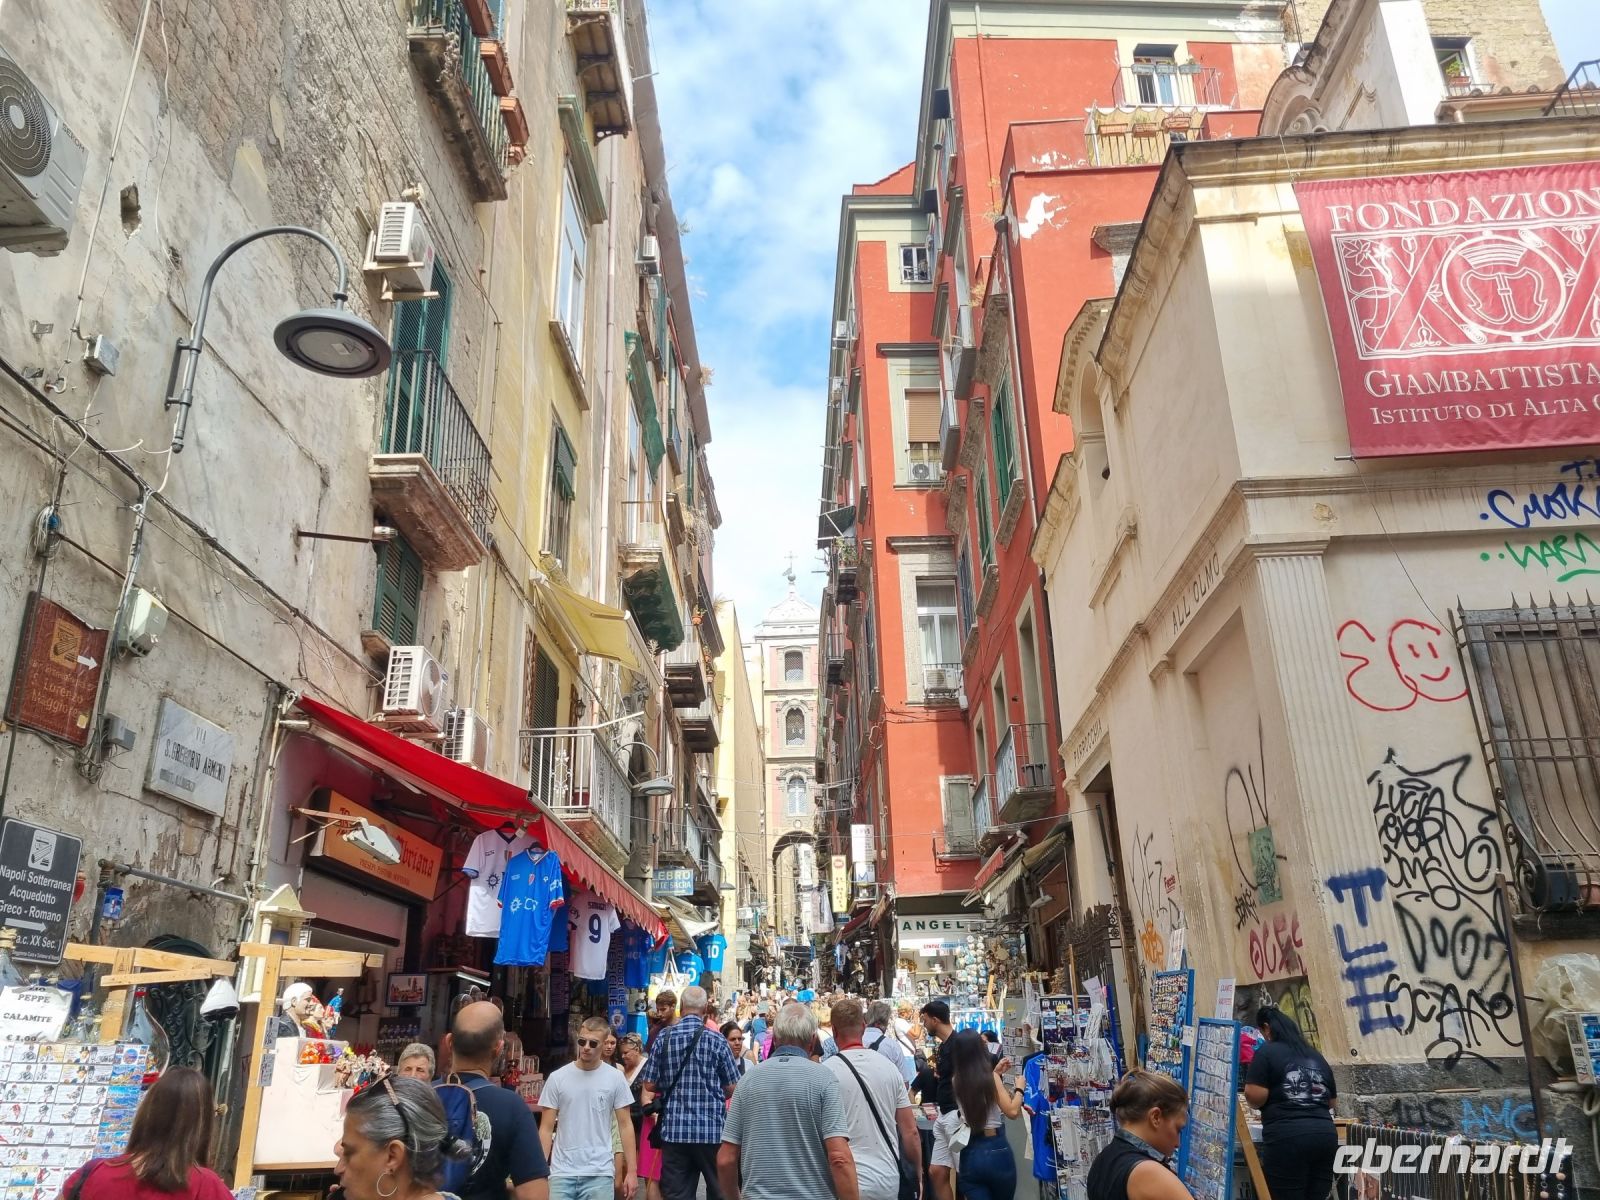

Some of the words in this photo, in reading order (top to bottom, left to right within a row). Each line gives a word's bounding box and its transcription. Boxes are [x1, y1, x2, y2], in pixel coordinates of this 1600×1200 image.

[1364, 362, 1600, 398] GIAMBATTISTA
[1370, 404, 1483, 425] ISTITUTO
[1488, 401, 1516, 419] DI
[1523, 397, 1588, 417] ALTA
[1172, 552, 1220, 635] ALL'OLMO
[0, 865, 27, 882] Napoli
[27, 871, 72, 892] Sotterranea
[652, 871, 691, 881] EBRO
[9, 885, 56, 905] Acquedotto
[0, 900, 23, 915] Greco
[28, 905, 62, 922] Romano
[588, 913, 602, 943] 9
[902, 920, 965, 931] ANGEL
[30, 935, 41, 946] XX
[706, 945, 719, 959] 10
[18, 993, 52, 1004] PEPPE
[3, 1012, 53, 1023] CALAMITE
